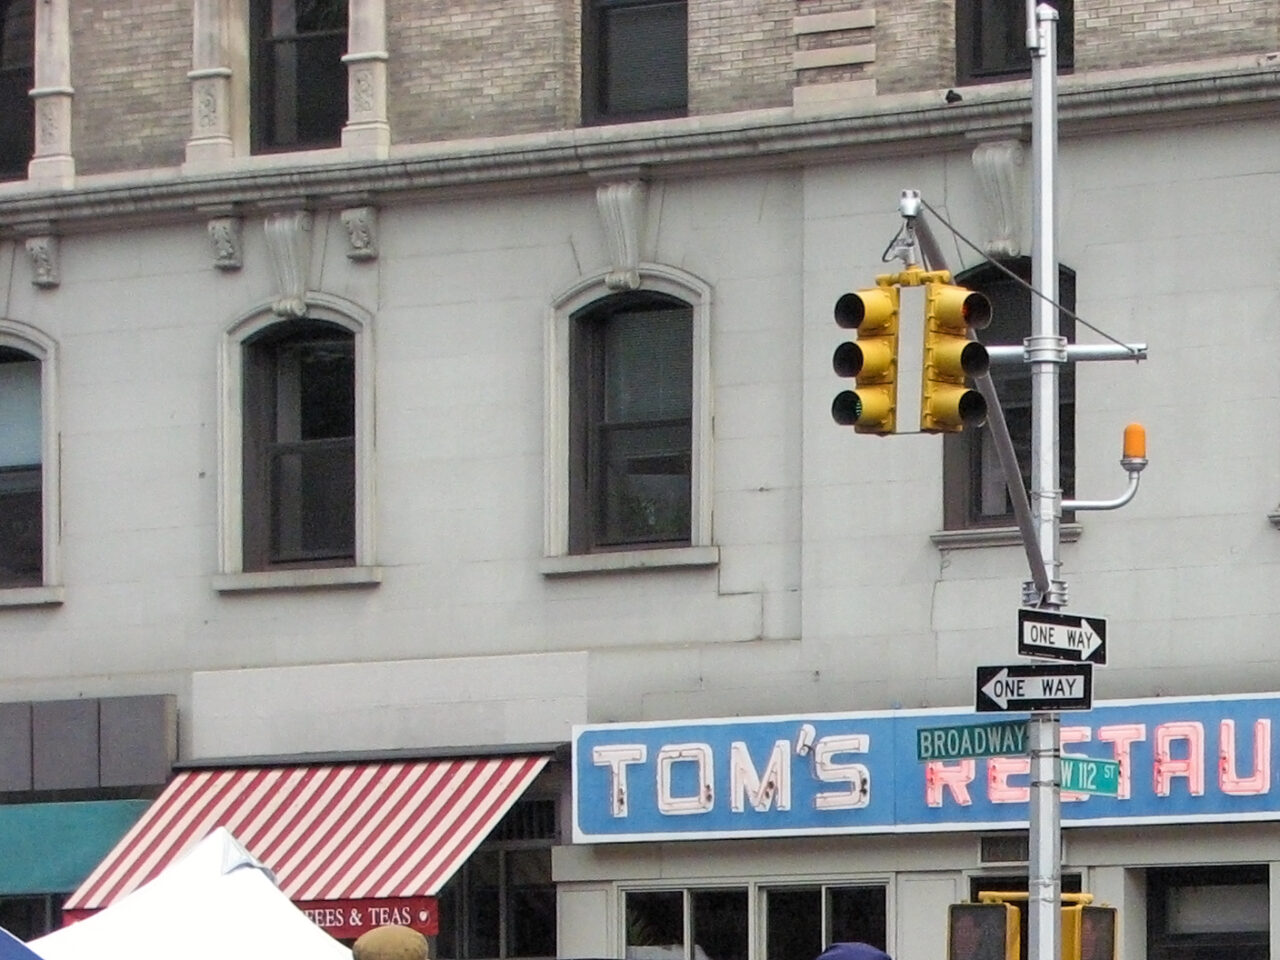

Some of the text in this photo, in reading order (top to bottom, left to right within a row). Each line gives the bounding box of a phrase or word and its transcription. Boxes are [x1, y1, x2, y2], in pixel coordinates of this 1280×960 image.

[1030, 624, 1093, 649] ONE WAY
[993, 678, 1077, 698] ONE WAY
[920, 722, 1028, 758] BROADWAY
[592, 724, 871, 818] TOM'S
[1060, 759, 1116, 790] W 112 ST
[349, 907, 363, 926] &
[368, 906, 411, 926] TEAS
